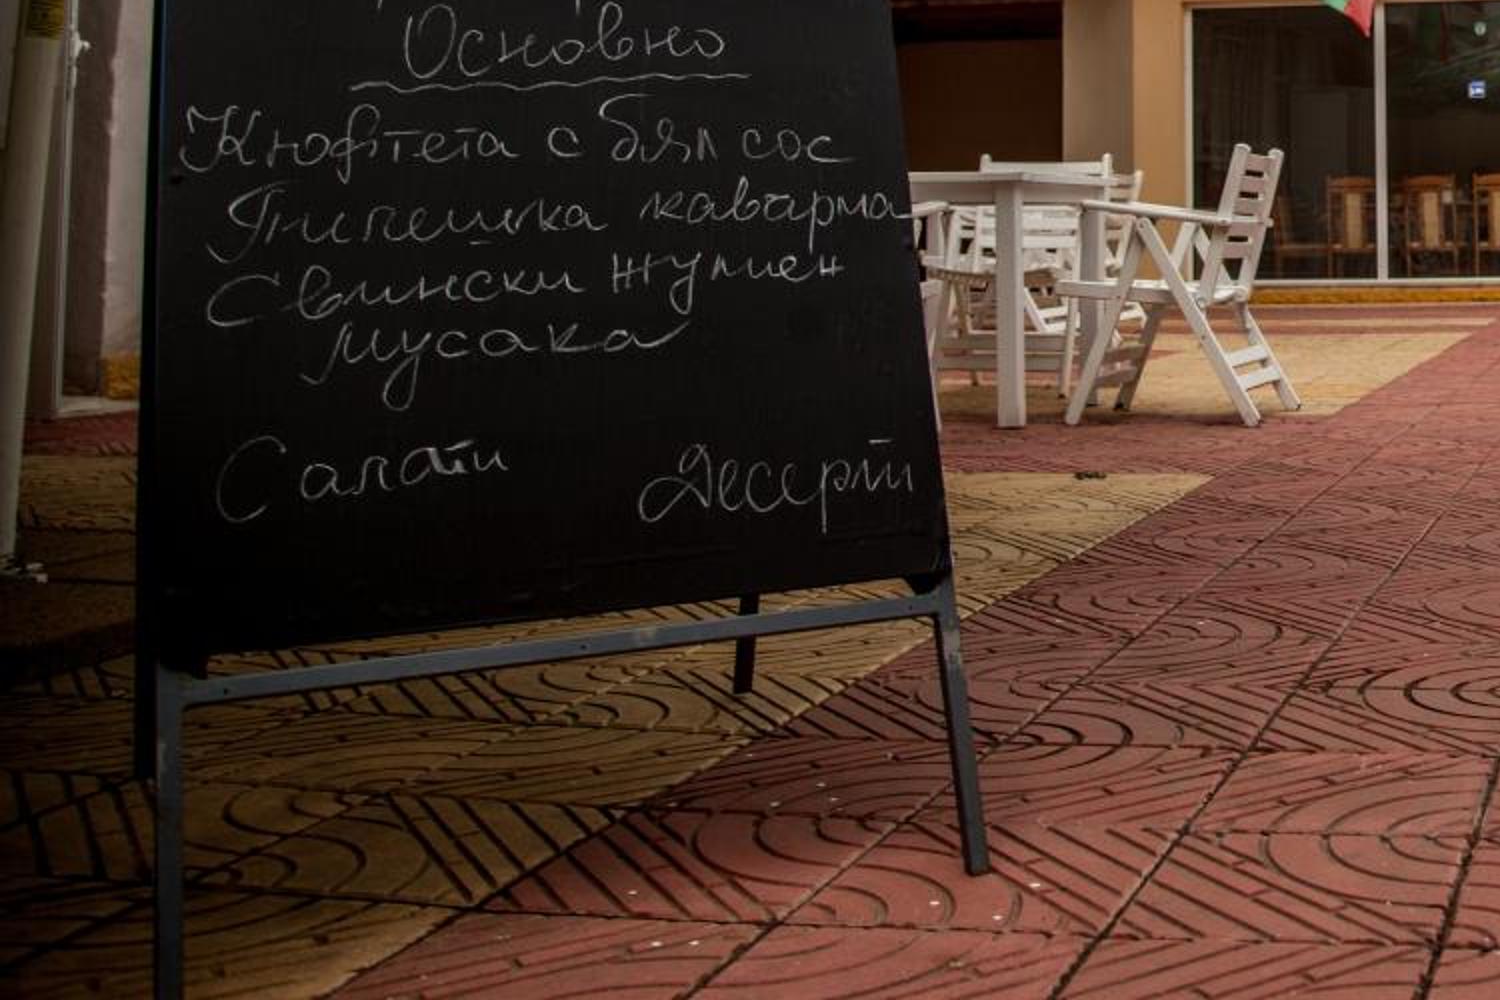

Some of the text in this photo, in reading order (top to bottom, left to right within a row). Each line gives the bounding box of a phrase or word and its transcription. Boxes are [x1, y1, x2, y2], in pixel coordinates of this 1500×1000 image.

[403, 2, 726, 79] Основно
[741, 129, 854, 164] сос
[206, 263, 587, 328] Свински
